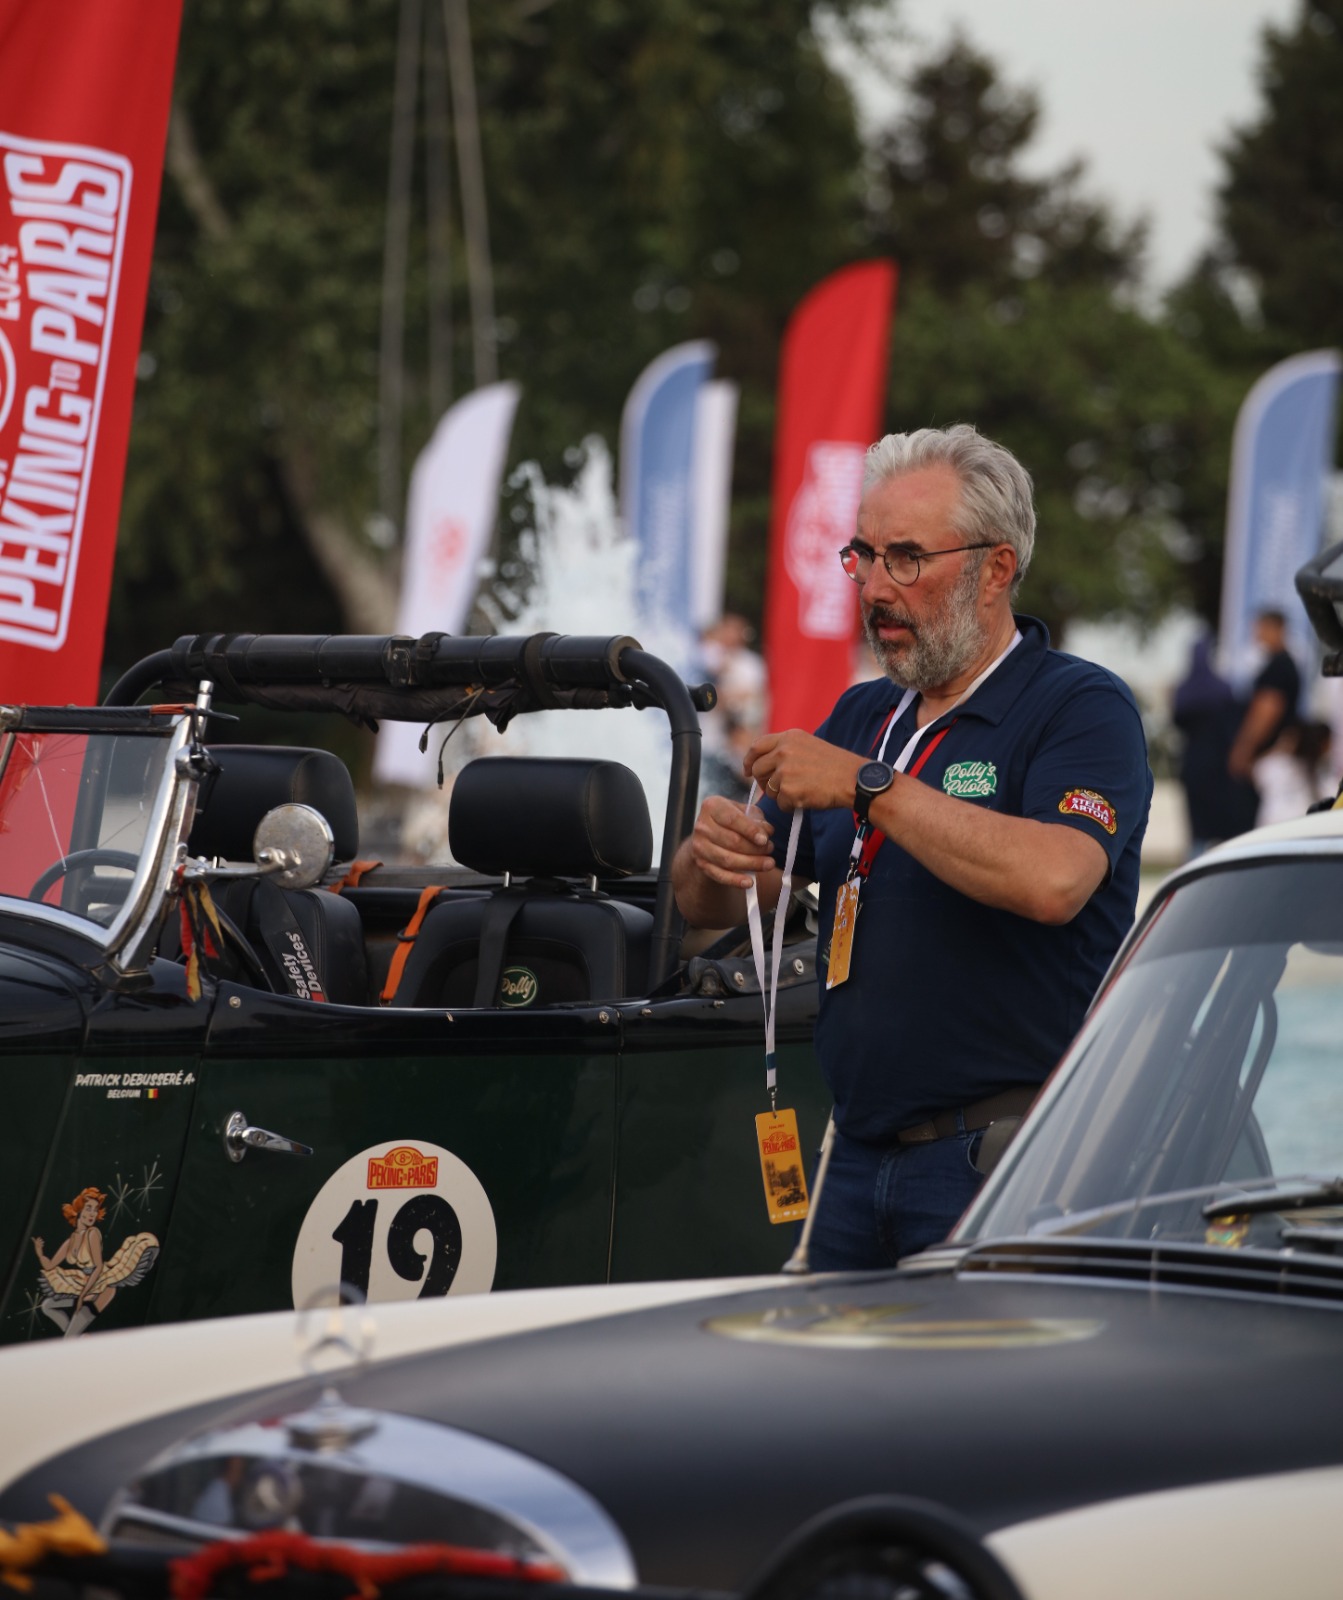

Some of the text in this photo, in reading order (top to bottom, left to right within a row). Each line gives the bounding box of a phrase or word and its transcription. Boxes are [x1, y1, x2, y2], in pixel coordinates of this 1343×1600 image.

[3, 150, 121, 366] PARIS
[0, 386, 92, 632] PEKING
[945, 761, 996, 782] Polly's
[944, 779, 996, 796] Pilots
[1070, 803, 1109, 825] ARTOIS
[1072, 797, 1109, 818] STELLA
[289, 932, 322, 991] Devices
[281, 952, 311, 999] Safety
[75, 1073, 121, 1087] PATRICK
[106, 1089, 141, 1099] BELGIUM
[369, 1161, 436, 1187] PEKING PARIS
[332, 1194, 463, 1306] 19
